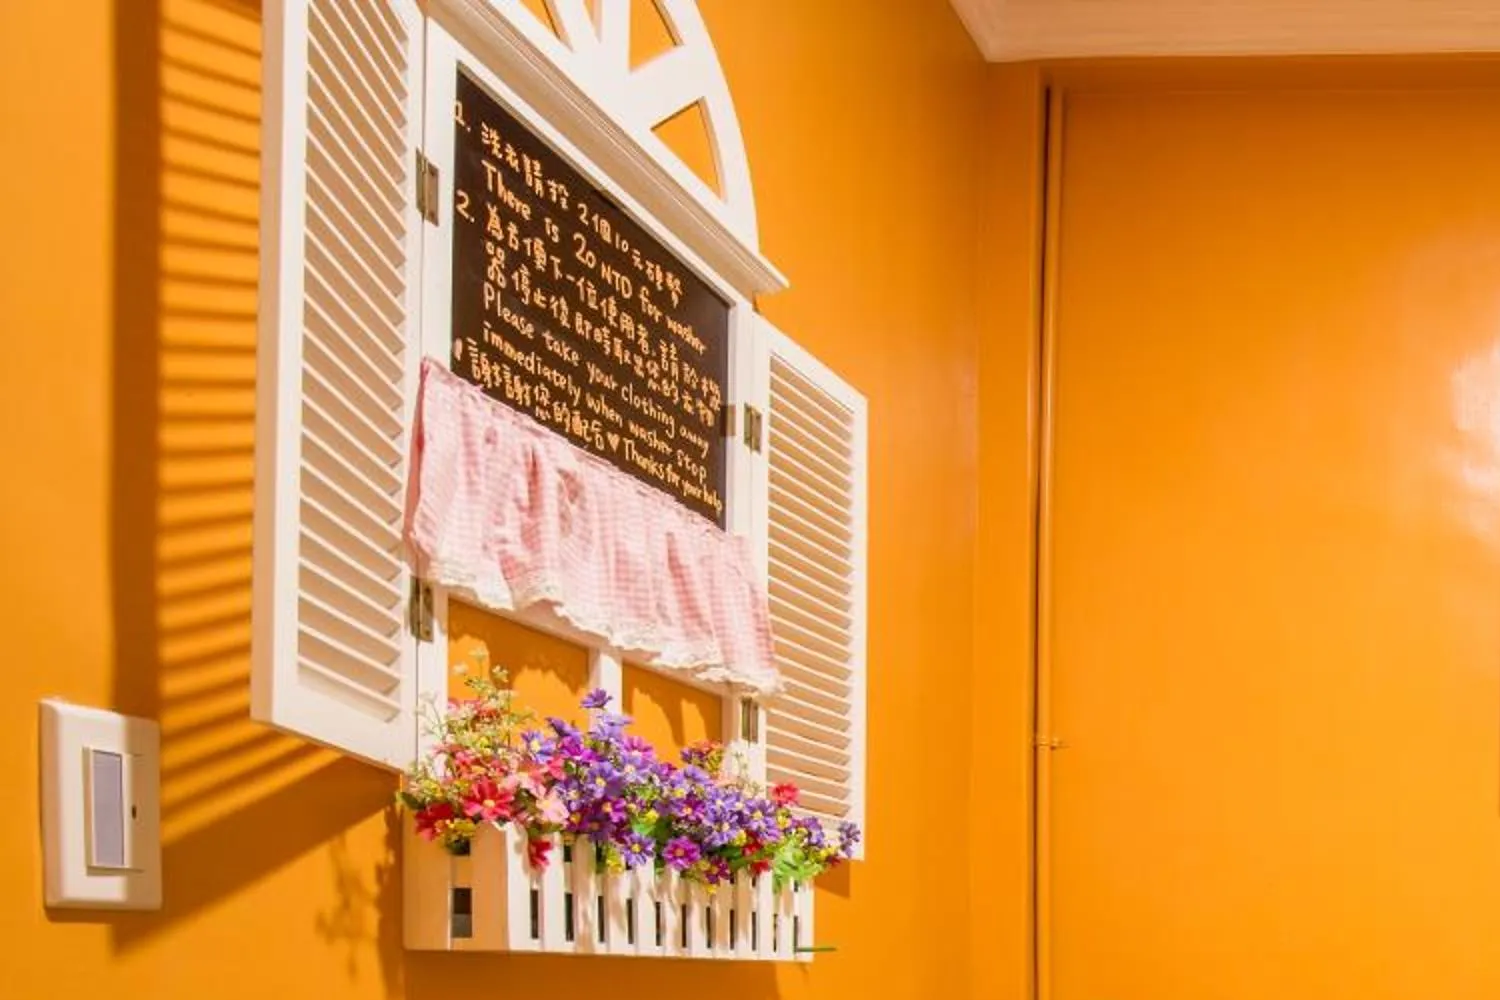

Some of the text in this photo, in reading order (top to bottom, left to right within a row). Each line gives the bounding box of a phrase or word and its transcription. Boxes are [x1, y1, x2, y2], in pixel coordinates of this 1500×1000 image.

[482, 160, 706, 355] There is 20 NTD for washer
[484, 282, 534, 339] Please
[543, 331, 579, 366] take
[621, 383, 675, 439] clothing
[680, 426, 709, 459] away
[484, 321, 707, 489] immediately when washer stop
[623, 438, 664, 480] Thanks
[664, 464, 680, 487] for
